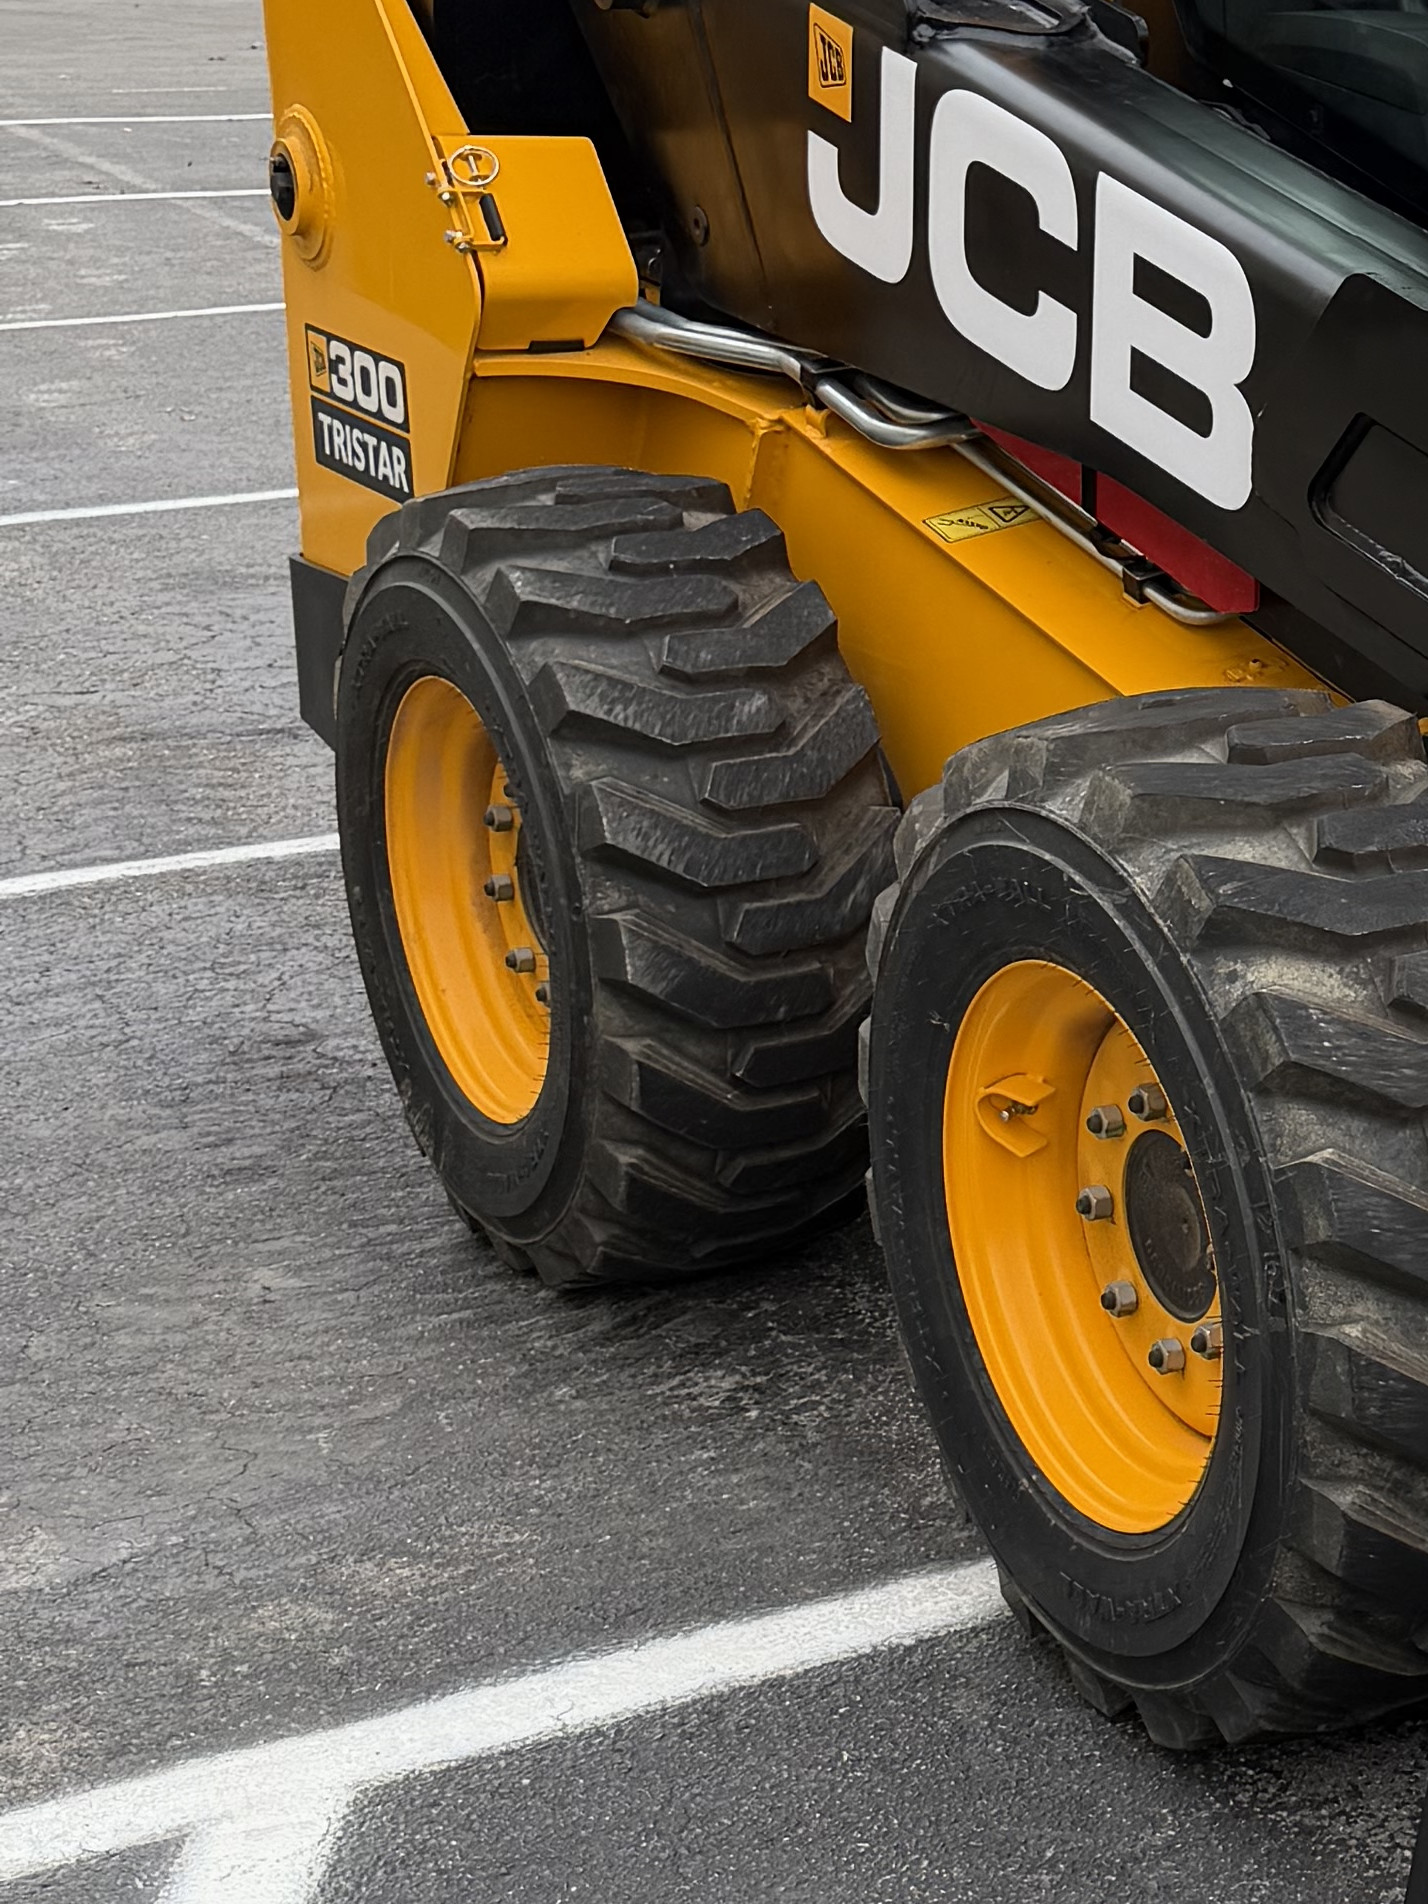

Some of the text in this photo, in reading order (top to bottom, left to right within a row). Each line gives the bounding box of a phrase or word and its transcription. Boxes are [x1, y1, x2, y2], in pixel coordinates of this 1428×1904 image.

[819, 31, 845, 82] JCB
[807, 45, 1257, 511] JCB
[329, 339, 406, 424] 300
[317, 411, 410, 494] TRISTAR
